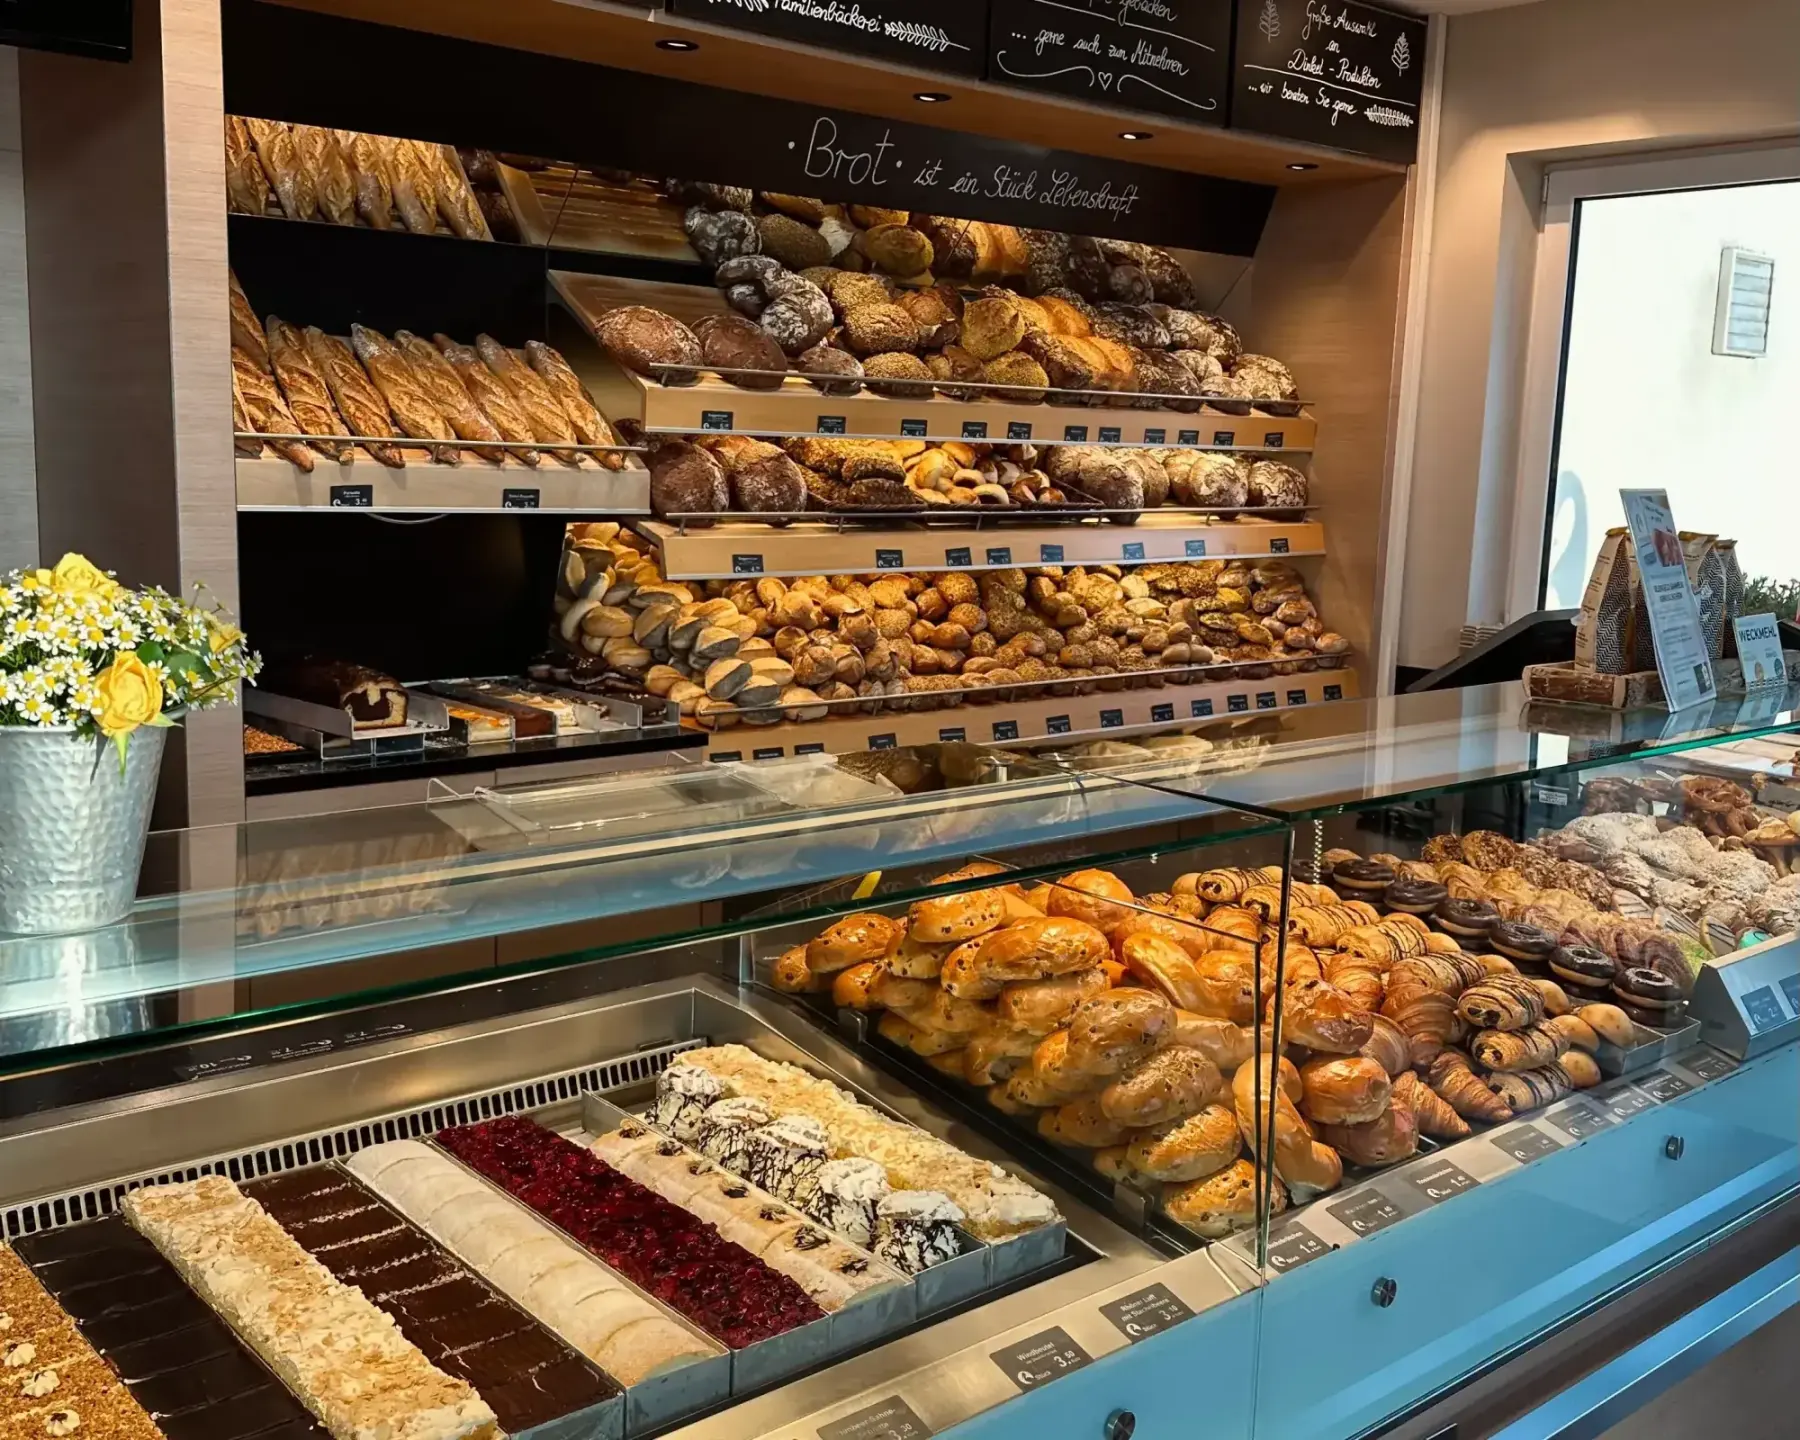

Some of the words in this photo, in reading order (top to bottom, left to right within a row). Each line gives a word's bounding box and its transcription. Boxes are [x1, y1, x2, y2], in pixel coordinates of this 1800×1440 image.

[1301, 0, 1331, 40] Große
[1333, 9, 1378, 38] Auswahl
[1034, 29, 1065, 56] gerne
[1073, 34, 1101, 54] auch
[1108, 44, 1128, 61] zum
[1130, 38, 1190, 76] Mitnehmen
[1325, 40, 1340, 53] an
[1288, 48, 1324, 76] Dinkel
[1336, 58, 1382, 89] Produkten
[1281, 81, 1310, 105] beraten
[1316, 86, 1330, 108] Sie
[1332, 99, 1358, 127] gerne
[804, 117, 895, 185] Brot
[913, 159, 943, 186] ist
[949, 172, 979, 196] ein
[984, 165, 1037, 200] Stück
[1039, 169, 1140, 222] Lebenskraft
[1738, 625, 1777, 643] WECKMEHL
[1016, 1341, 1055, 1361] Windbeutel
[1035, 1370, 1052, 1380] Stück
